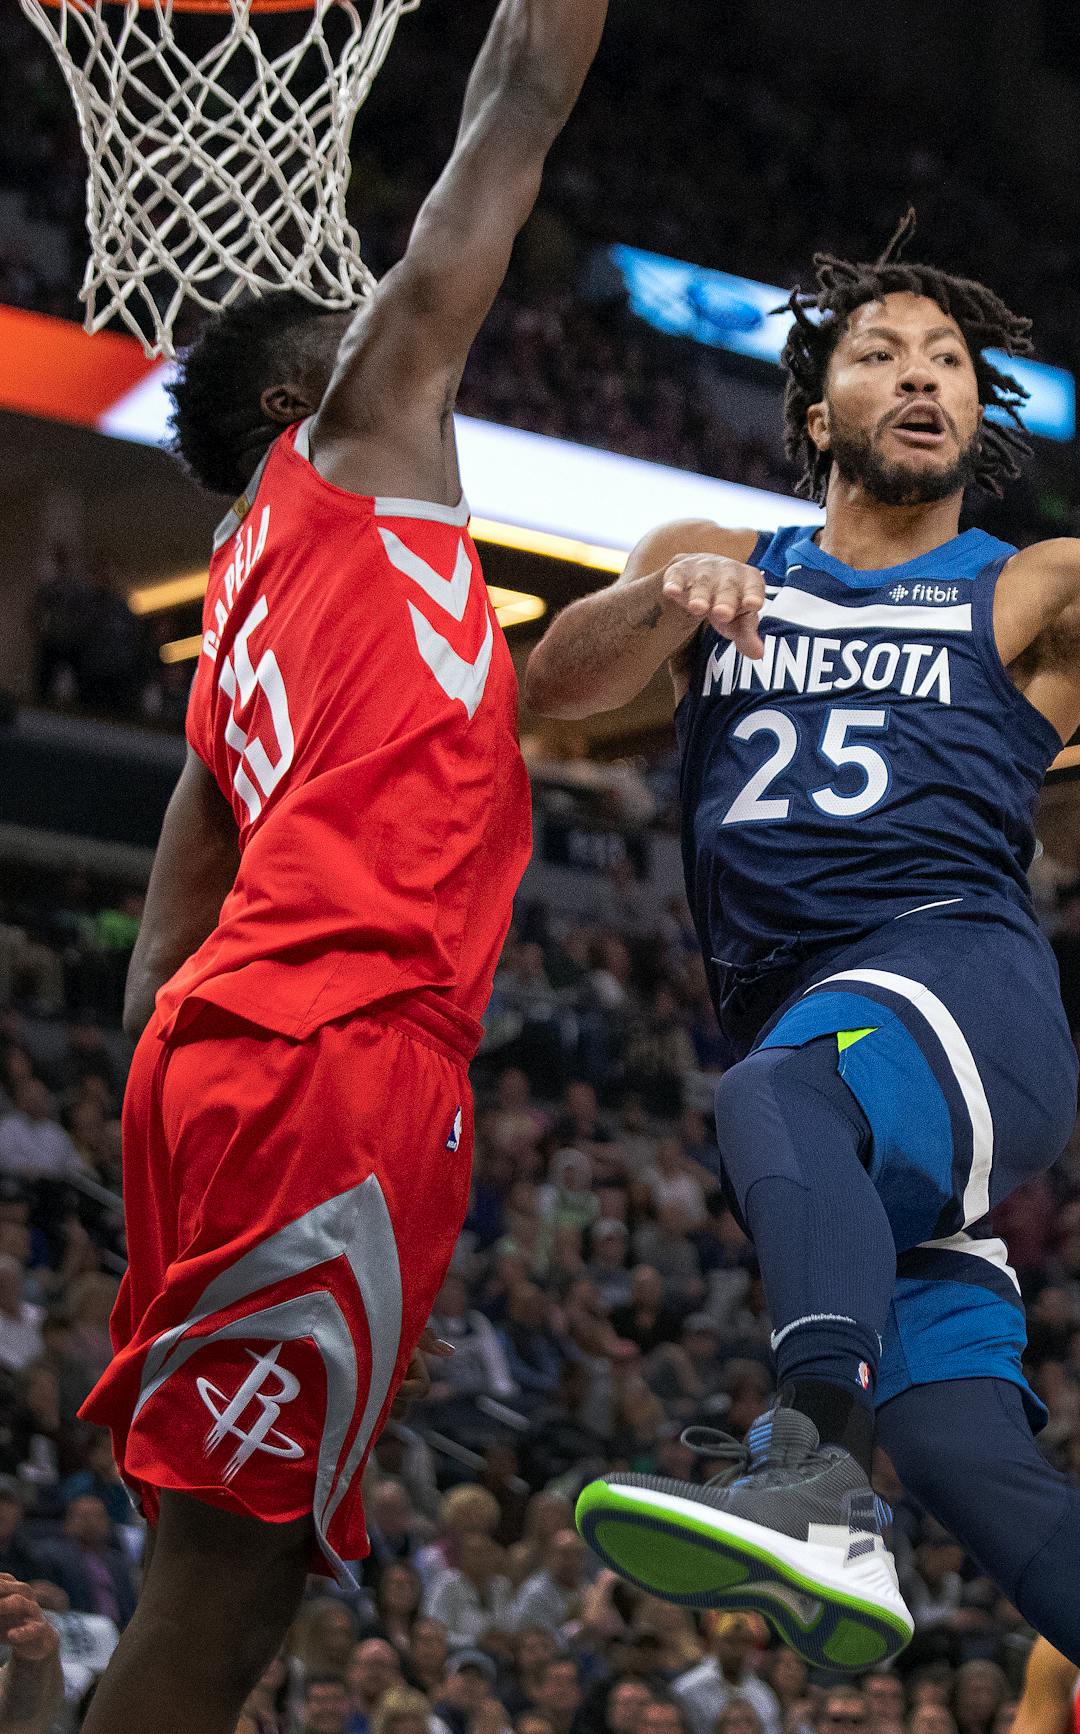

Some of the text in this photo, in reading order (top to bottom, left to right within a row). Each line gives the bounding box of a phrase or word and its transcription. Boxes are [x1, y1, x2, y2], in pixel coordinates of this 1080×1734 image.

[912, 584, 959, 602] fitbit
[702, 634, 951, 705] MNNESOTA
[721, 707, 890, 825] 25
